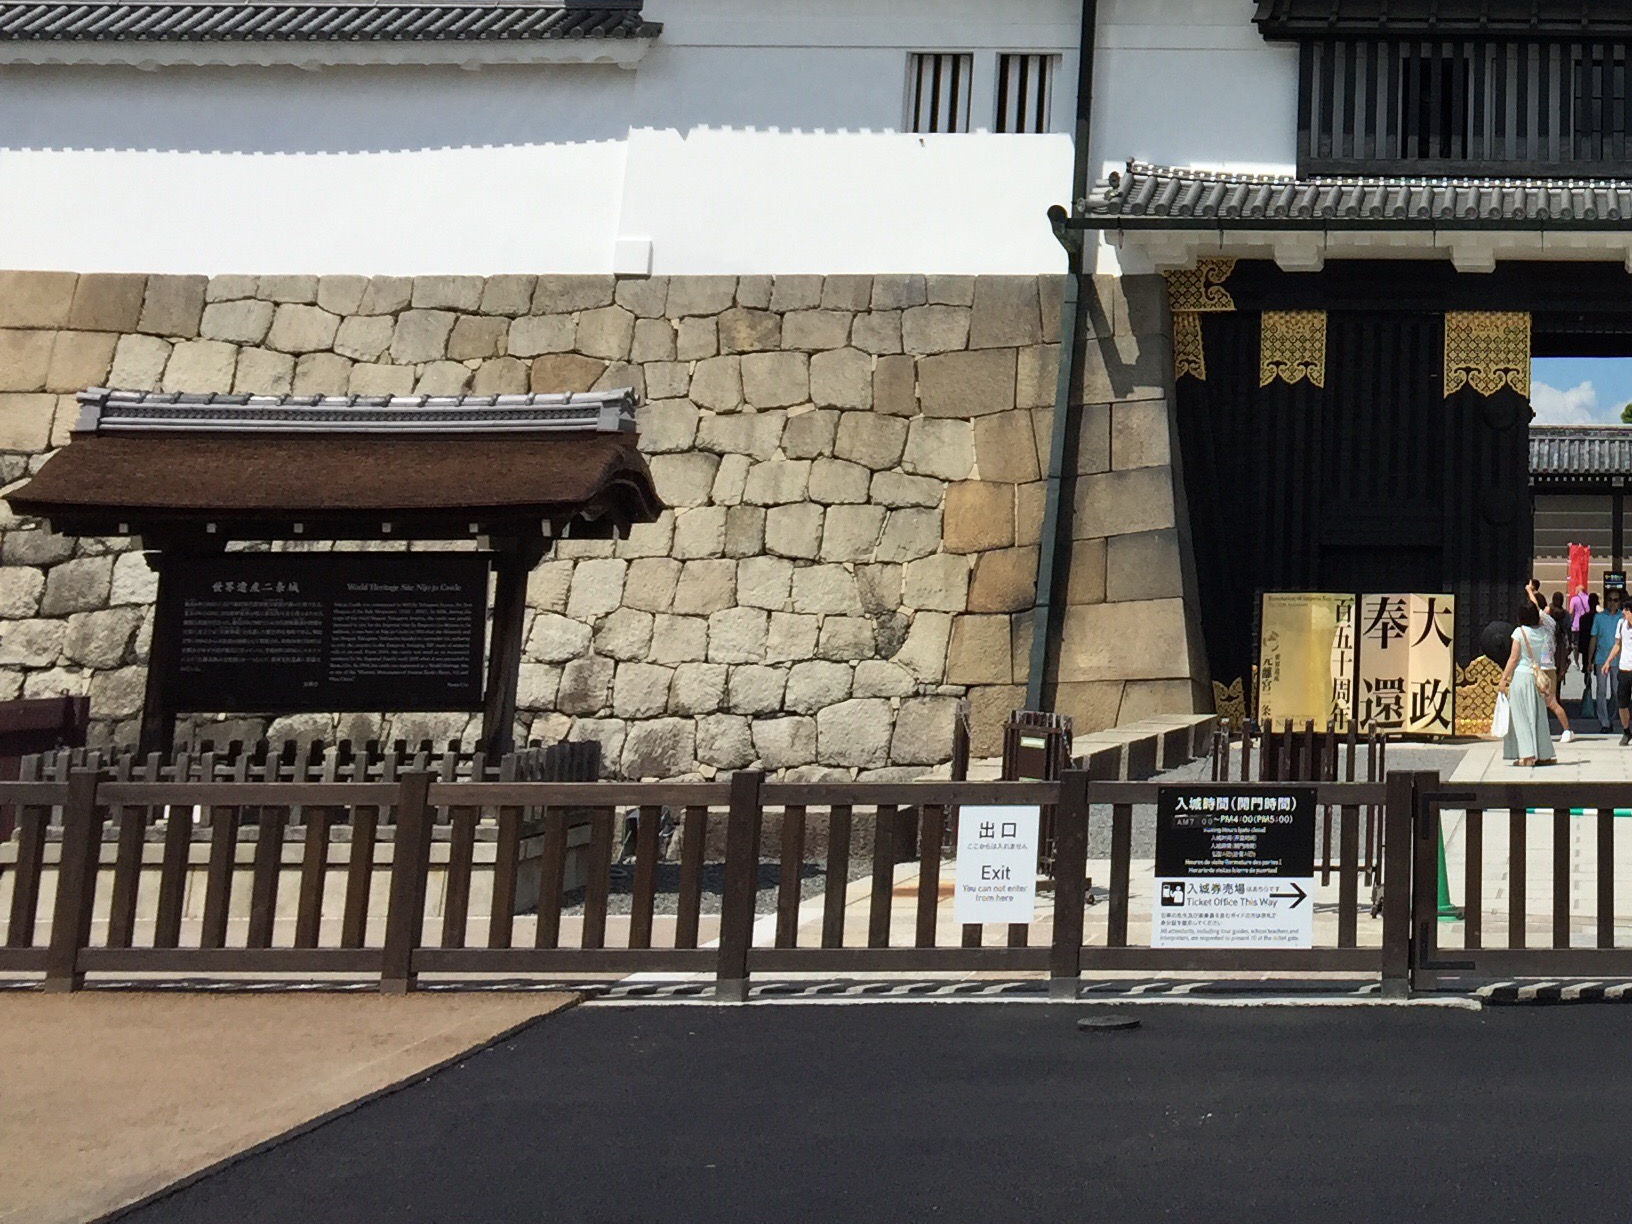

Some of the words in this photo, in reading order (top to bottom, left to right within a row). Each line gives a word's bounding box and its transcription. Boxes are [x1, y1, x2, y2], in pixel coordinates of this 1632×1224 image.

[347, 583, 368, 591] World
[370, 583, 399, 592] Heritage
[1331, 597, 1354, 730] 百五十周年
[1360, 596, 1408, 730] 奉還
[1410, 596, 1453, 730] 大政
[1262, 655, 1273, 716] 元離宮二条
[979, 821, 1017, 838] 出口
[982, 865, 1010, 880] Exit
[1187, 883, 1245, 894] 入城券売場
[1187, 898, 1212, 906] Ticket
[1214, 898, 1237, 906] Office
[1240, 898, 1257, 906] This
[1260, 898, 1278, 908] Way
